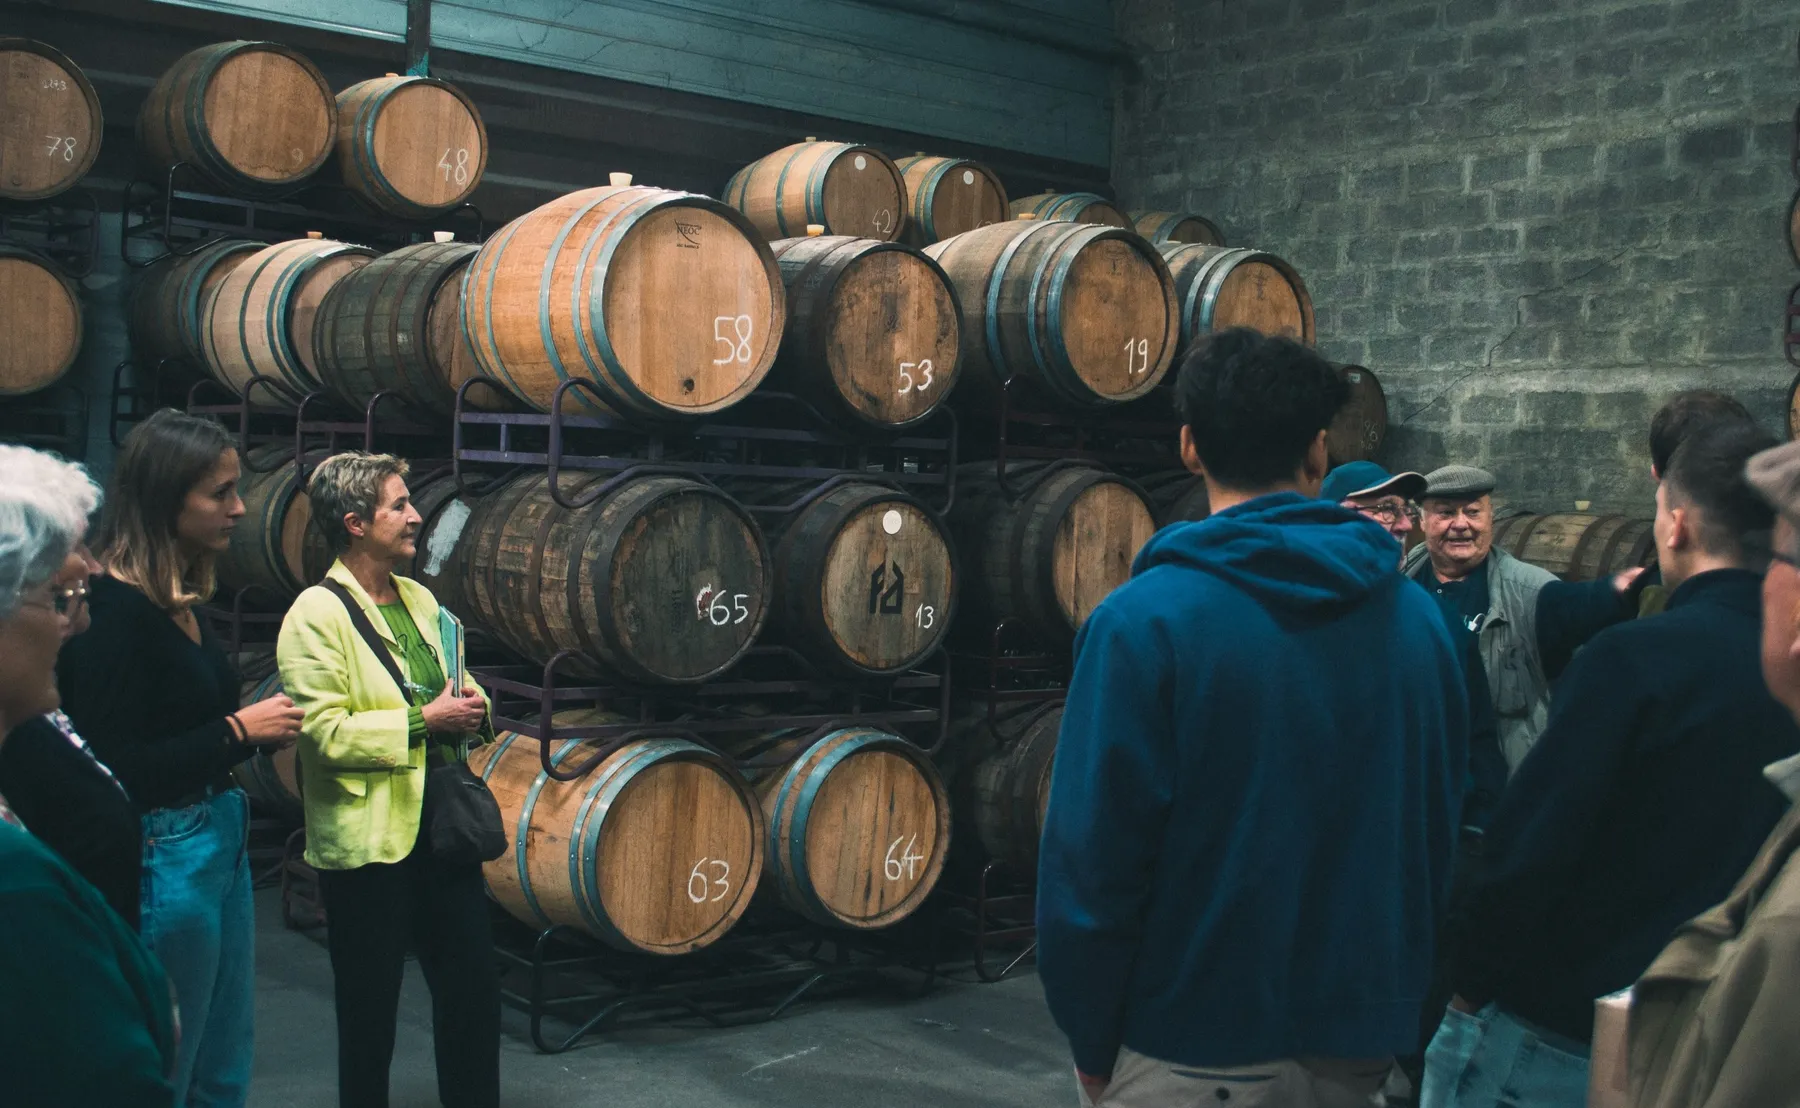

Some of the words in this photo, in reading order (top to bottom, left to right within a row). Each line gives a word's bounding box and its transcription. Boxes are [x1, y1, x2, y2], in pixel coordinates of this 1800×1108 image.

[45, 135, 77, 162] 78
[438, 147, 469, 186] 48
[871, 209, 891, 234] 42
[713, 314, 753, 366] 58
[1124, 337, 1149, 375] 19
[898, 358, 933, 395] 53
[709, 589, 749, 626] 65
[915, 603, 934, 629] 13
[885, 832, 924, 881] 64
[688, 856, 730, 904] 63
